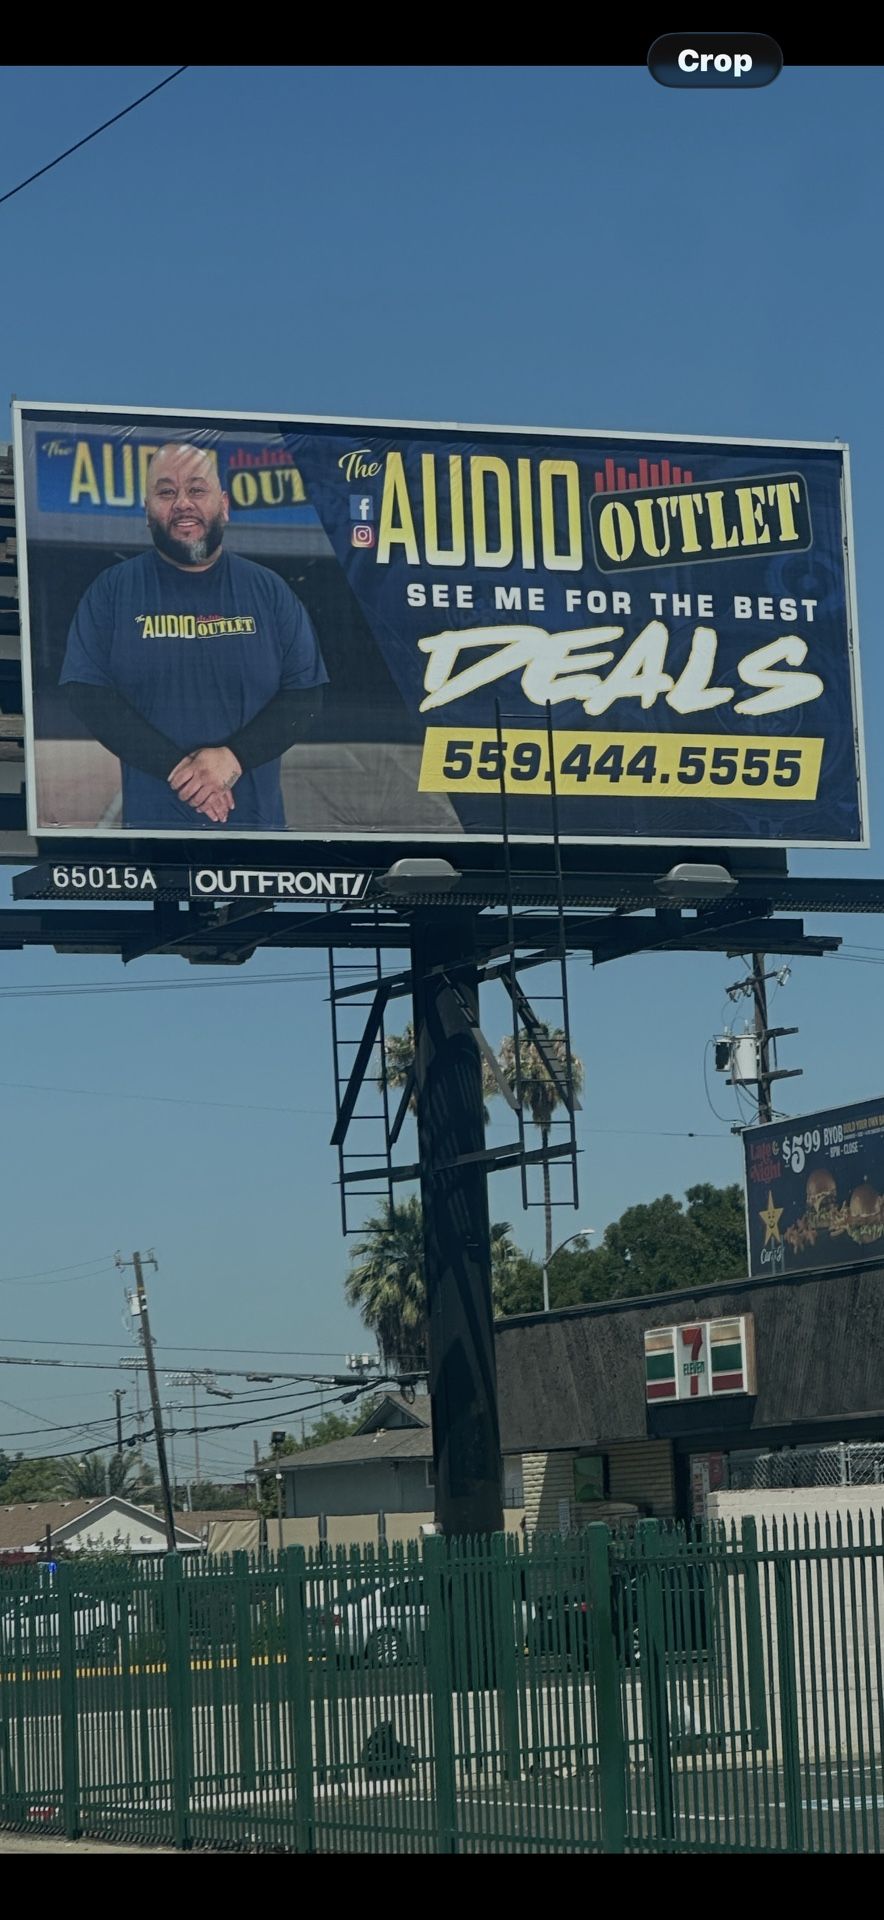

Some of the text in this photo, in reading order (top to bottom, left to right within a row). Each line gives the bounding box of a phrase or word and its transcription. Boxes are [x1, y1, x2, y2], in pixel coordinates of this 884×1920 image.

[338, 449, 801, 572] The AUDIO OUTLET
[406, 583, 818, 622] SEE ME FOR THE BEST
[142, 615, 196, 639] AUDIO
[198, 618, 253, 636] OUTLET
[418, 620, 824, 716] DEALS
[442, 740, 803, 788] 559.444.5555
[52, 866, 157, 889] 65015A
[823, 1124, 844, 1146] BYOB
